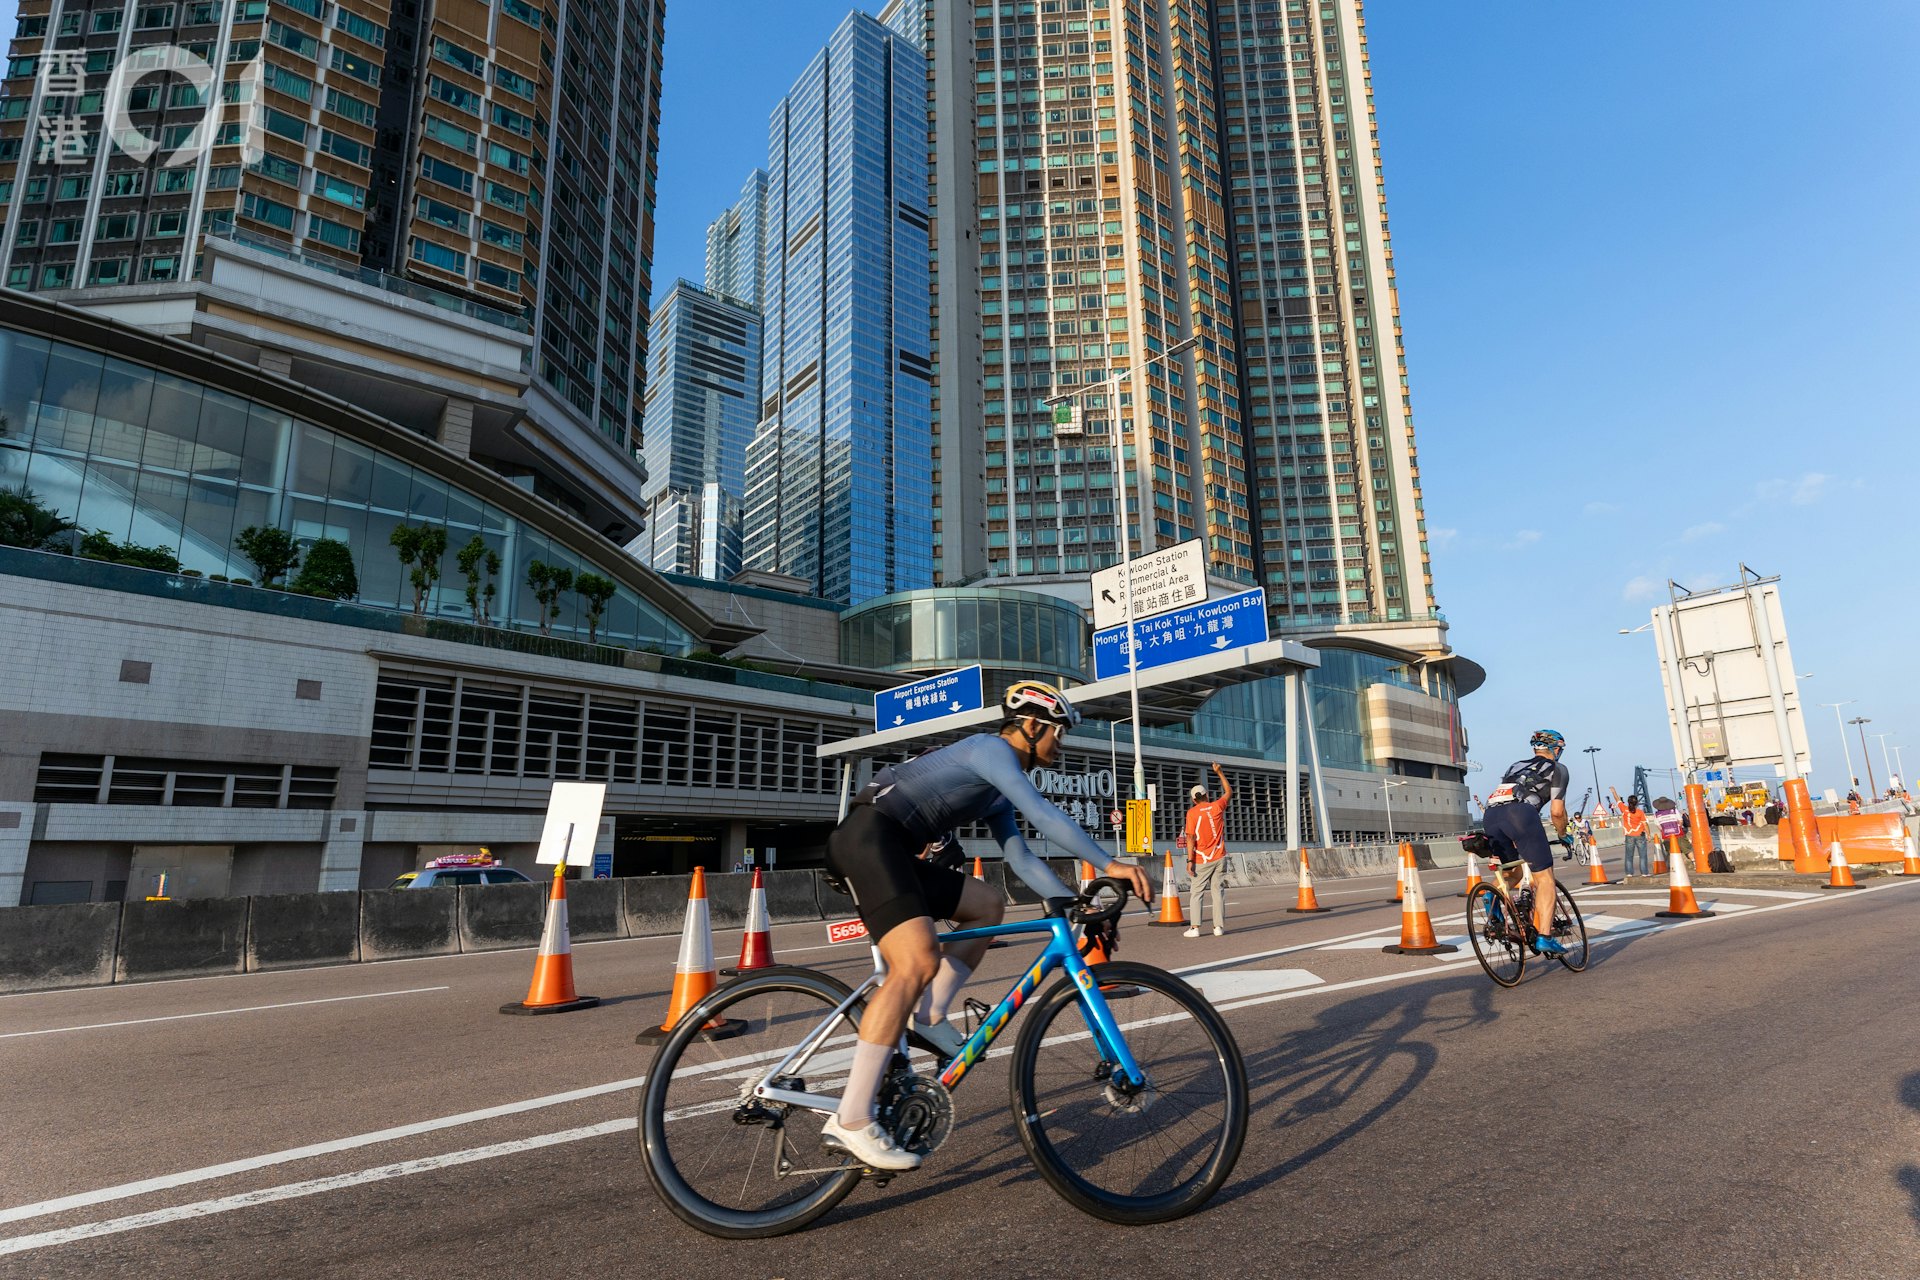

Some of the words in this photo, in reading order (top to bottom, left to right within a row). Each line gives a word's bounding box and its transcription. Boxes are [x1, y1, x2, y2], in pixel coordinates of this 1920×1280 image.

[1118, 561, 1153, 578] Kwloon
[1156, 550, 1188, 566] Station
[1119, 567, 1168, 589] Cmmercial
[1171, 564, 1177, 573] &
[1119, 580, 1166, 600] Rsidential
[1169, 574, 1189, 586] Area
[1096, 634, 1118, 647] Mong
[1120, 630, 1139, 641] Ko,
[1140, 622, 1153, 634] Tai
[1155, 616, 1172, 631] Kok
[1174, 611, 1195, 626] Tsui,
[1198, 601, 1240, 619] Kowloon
[1242, 595, 1263, 609] Bay
[894, 688, 913, 700] Airport
[914, 683, 936, 695] Express
[937, 676, 958, 689] Station
[1022, 767, 1114, 797] ORRENTO
[832, 922, 865, 938] 5696
